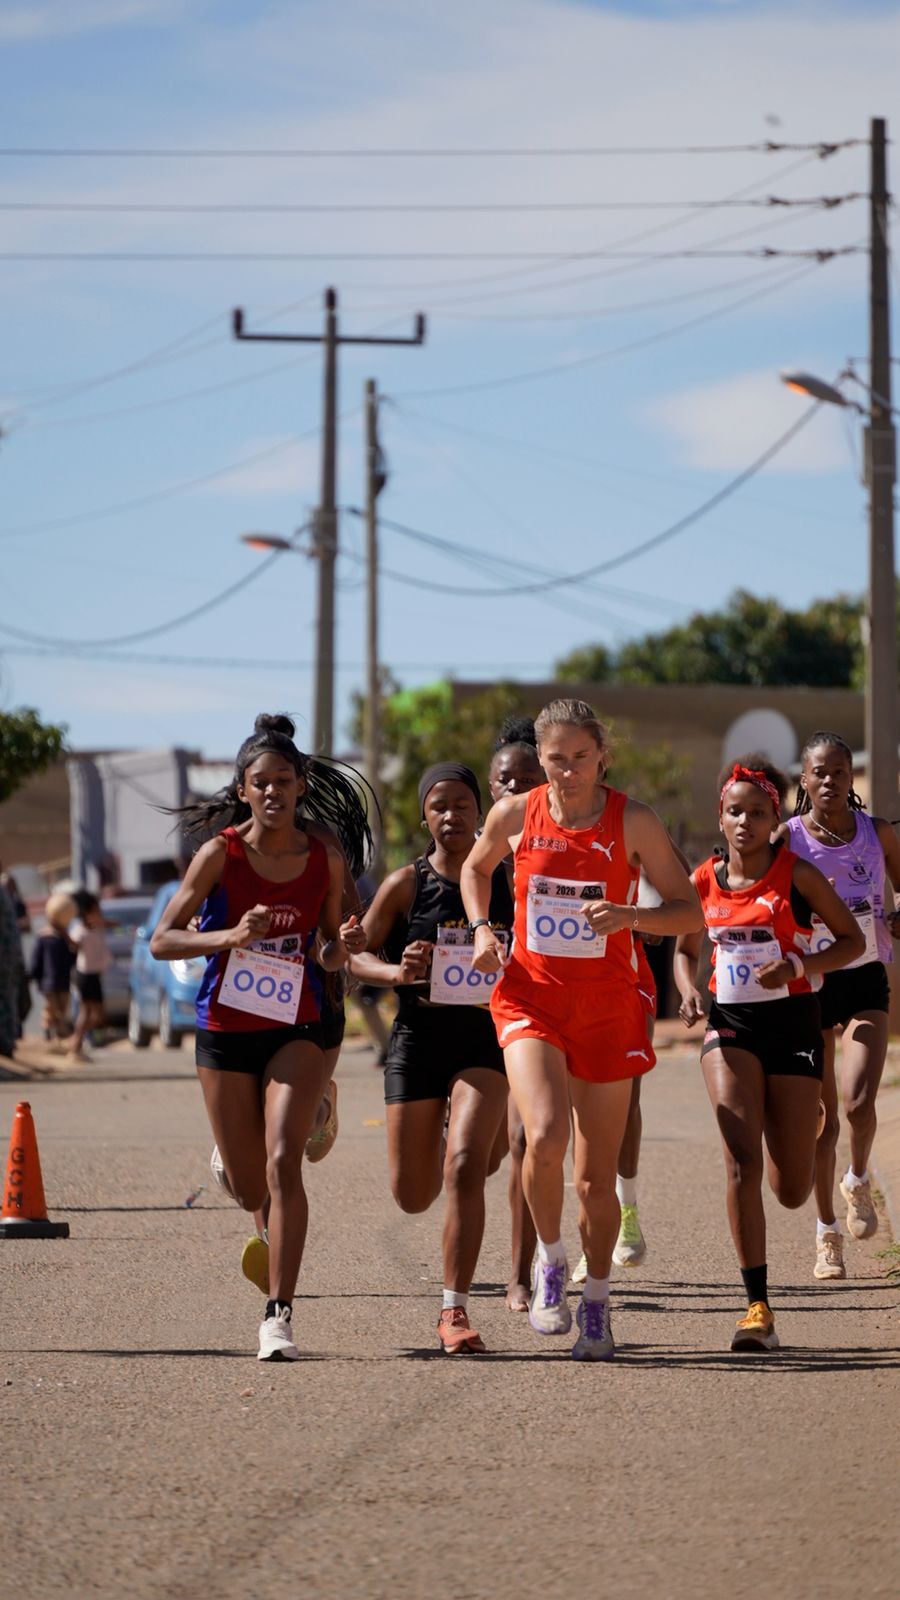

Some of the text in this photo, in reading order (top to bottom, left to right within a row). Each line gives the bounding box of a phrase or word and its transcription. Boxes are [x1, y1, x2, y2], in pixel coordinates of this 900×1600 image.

[556, 885, 576, 897] 2026
[535, 915, 597, 941] 005
[233, 969, 294, 1004] 008
[727, 963, 763, 986] 19
